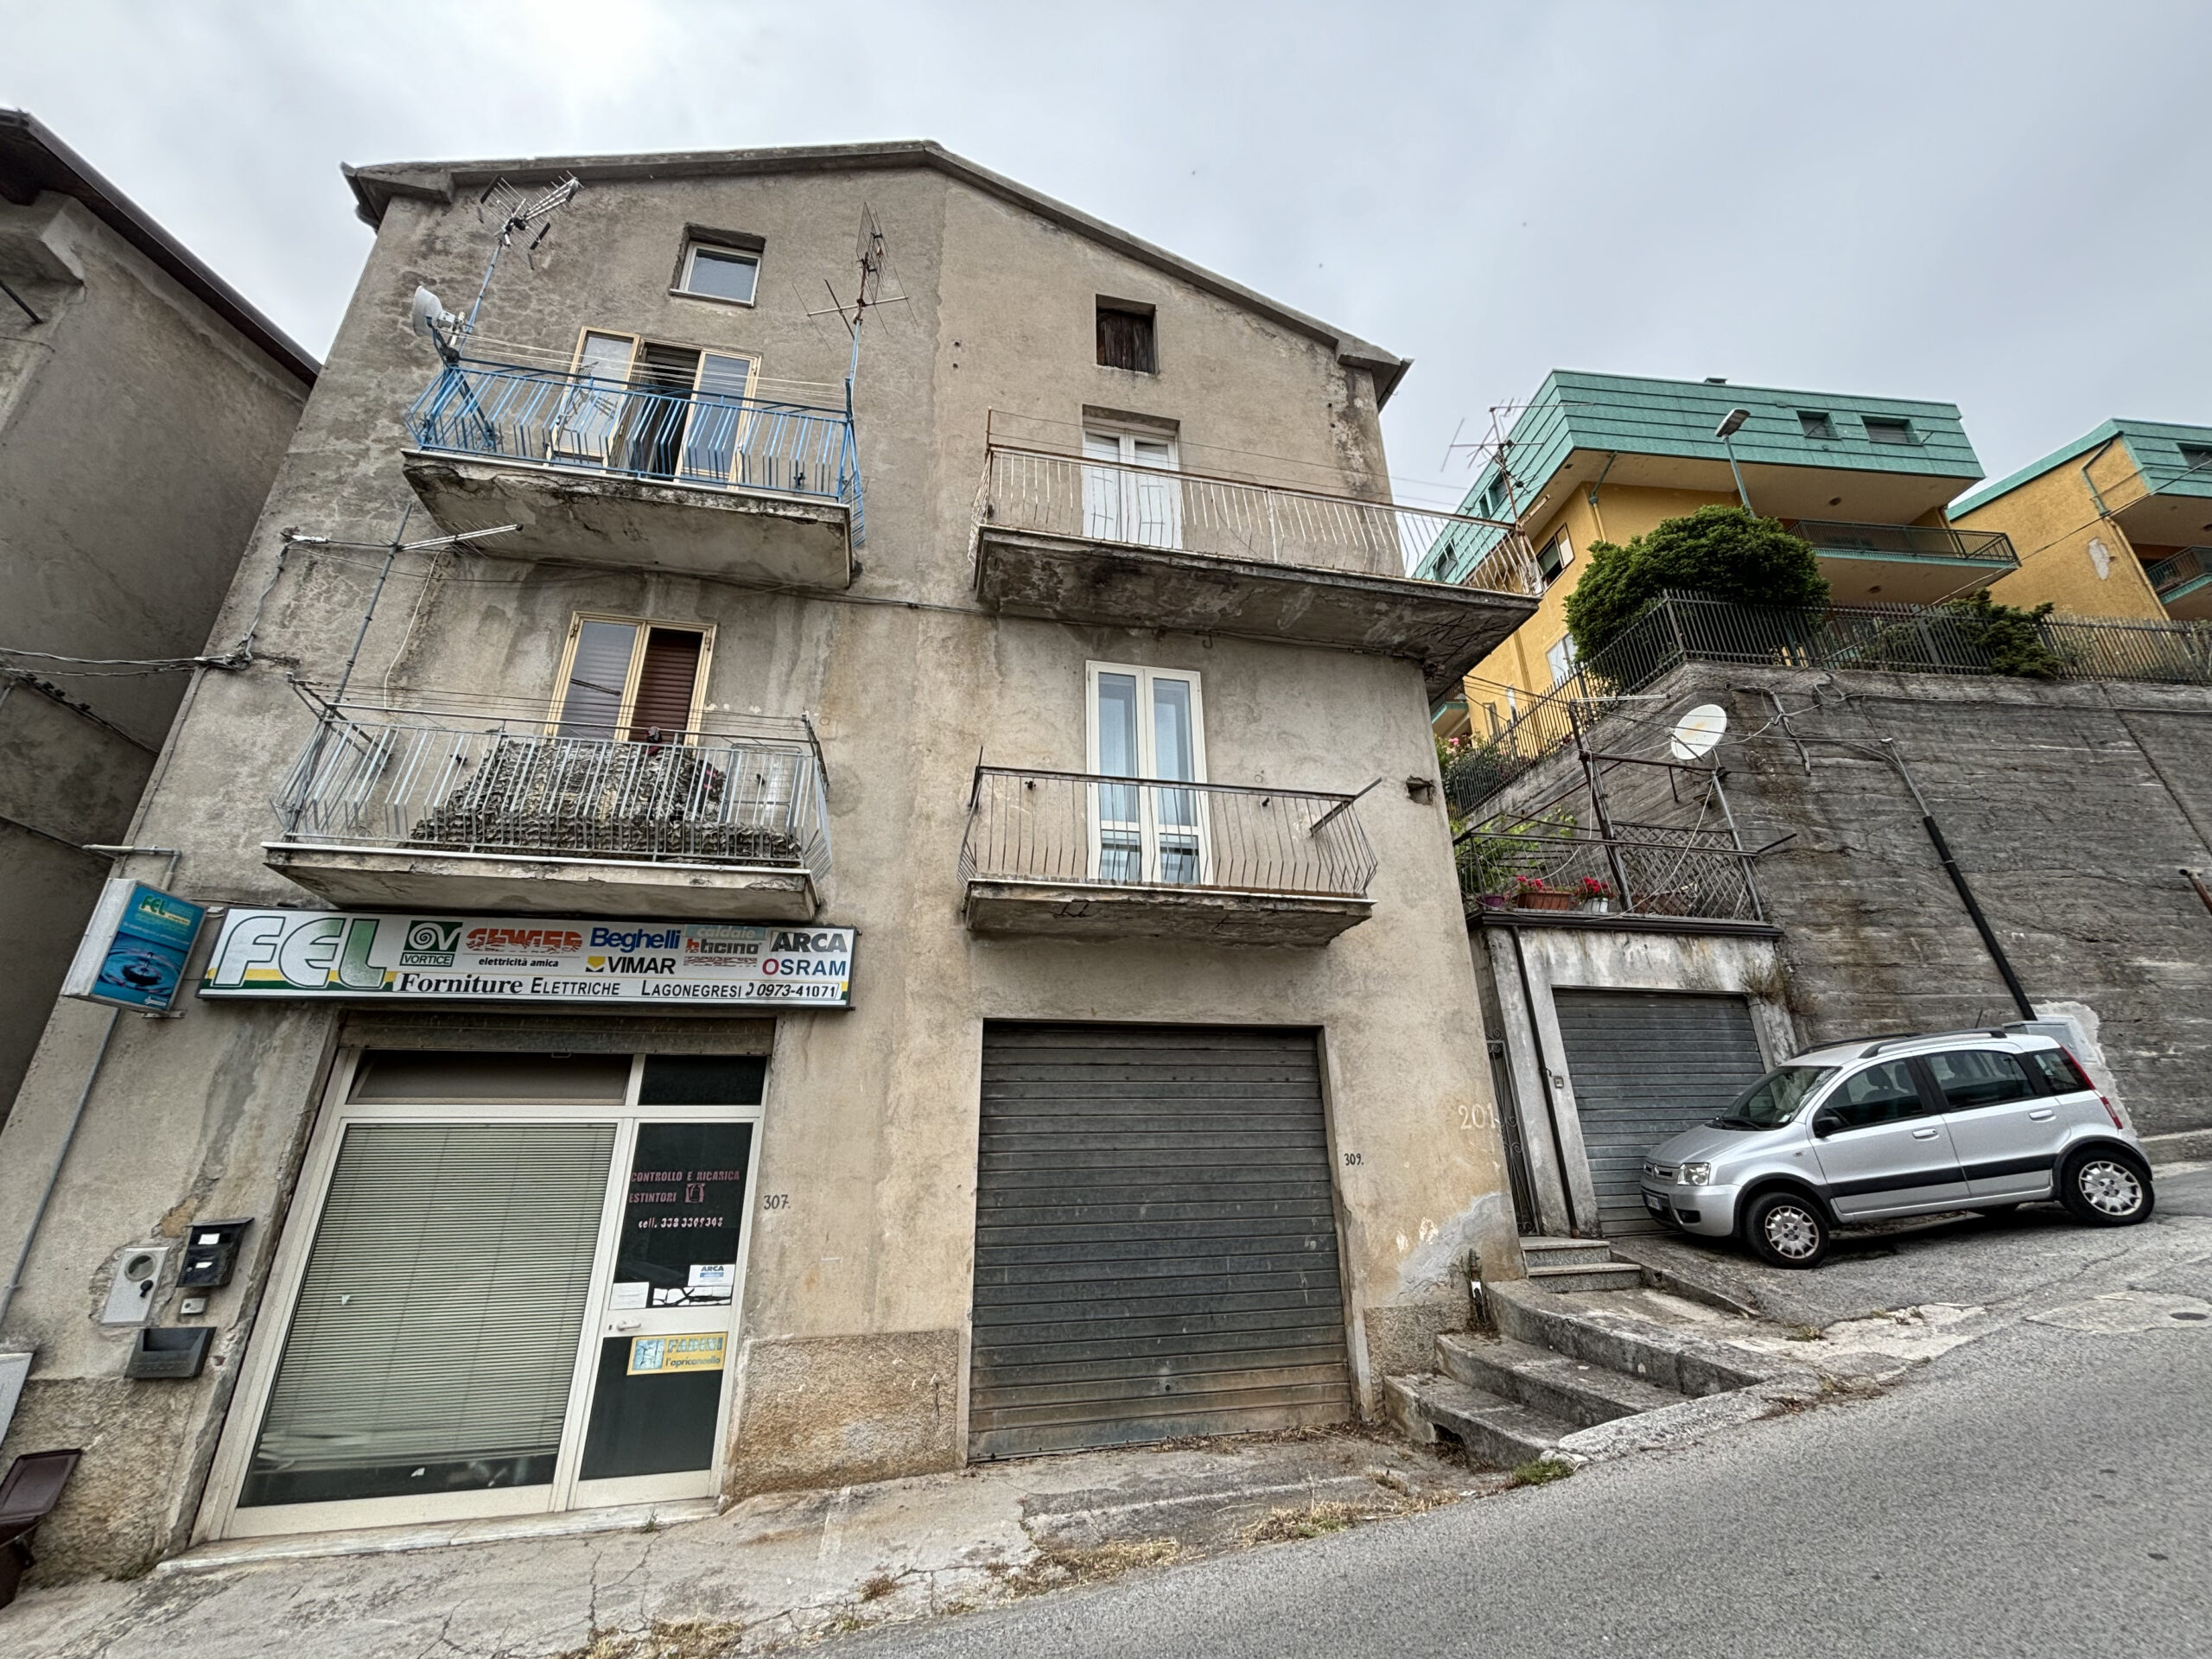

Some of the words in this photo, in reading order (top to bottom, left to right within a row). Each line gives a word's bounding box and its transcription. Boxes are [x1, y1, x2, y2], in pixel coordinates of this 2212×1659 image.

[141, 894, 167, 917] FEL
[589, 926, 682, 954] Beghelli
[696, 925, 756, 939] caldaie
[769, 931, 849, 953] ARCA
[210, 916, 387, 989] FEL
[404, 954, 452, 965] VORTICE
[478, 957, 528, 967] elettricità
[530, 959, 559, 968] amica
[607, 956, 677, 975] VIMAR
[762, 957, 847, 976] OSRAM
[397, 972, 524, 994] Forniture
[530, 976, 621, 995] ELETTRICHE
[641, 979, 742, 998] LAGONEGRESI
[756, 982, 836, 998] 0973-41071
[631, 1171, 683, 1183] CONTROLLO
[686, 1171, 693, 1181] E
[696, 1170, 741, 1181] RICARICA
[628, 1192, 677, 1204] ESTINTORI
[638, 1217, 658, 1229] cell.
